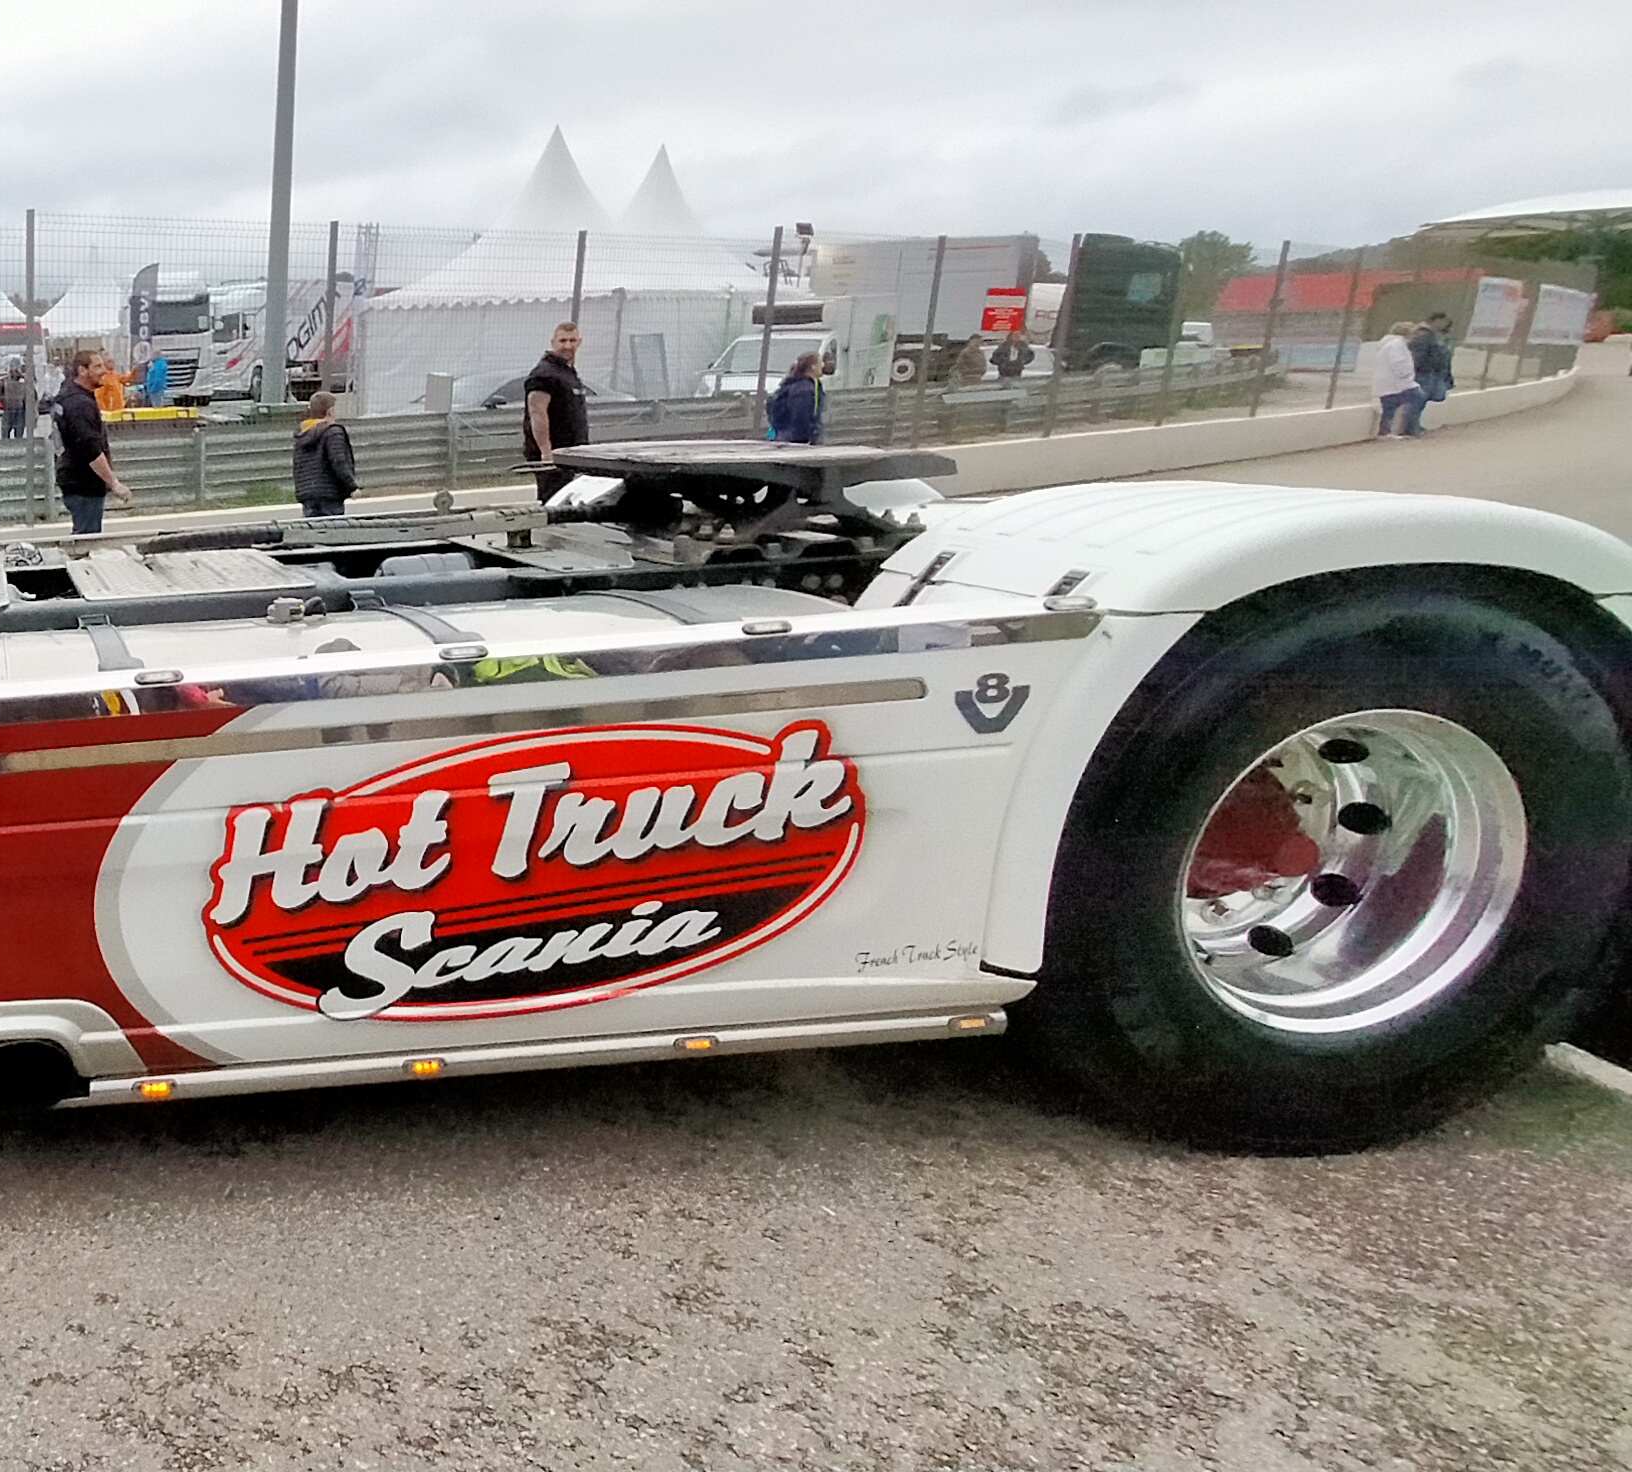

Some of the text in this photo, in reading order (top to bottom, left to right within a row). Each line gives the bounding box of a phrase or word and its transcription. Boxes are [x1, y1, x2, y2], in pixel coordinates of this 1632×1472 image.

[212, 729, 852, 923] Hot Truck
[319, 909, 720, 1020] Scania
[854, 940, 978, 973] French Truck Style
